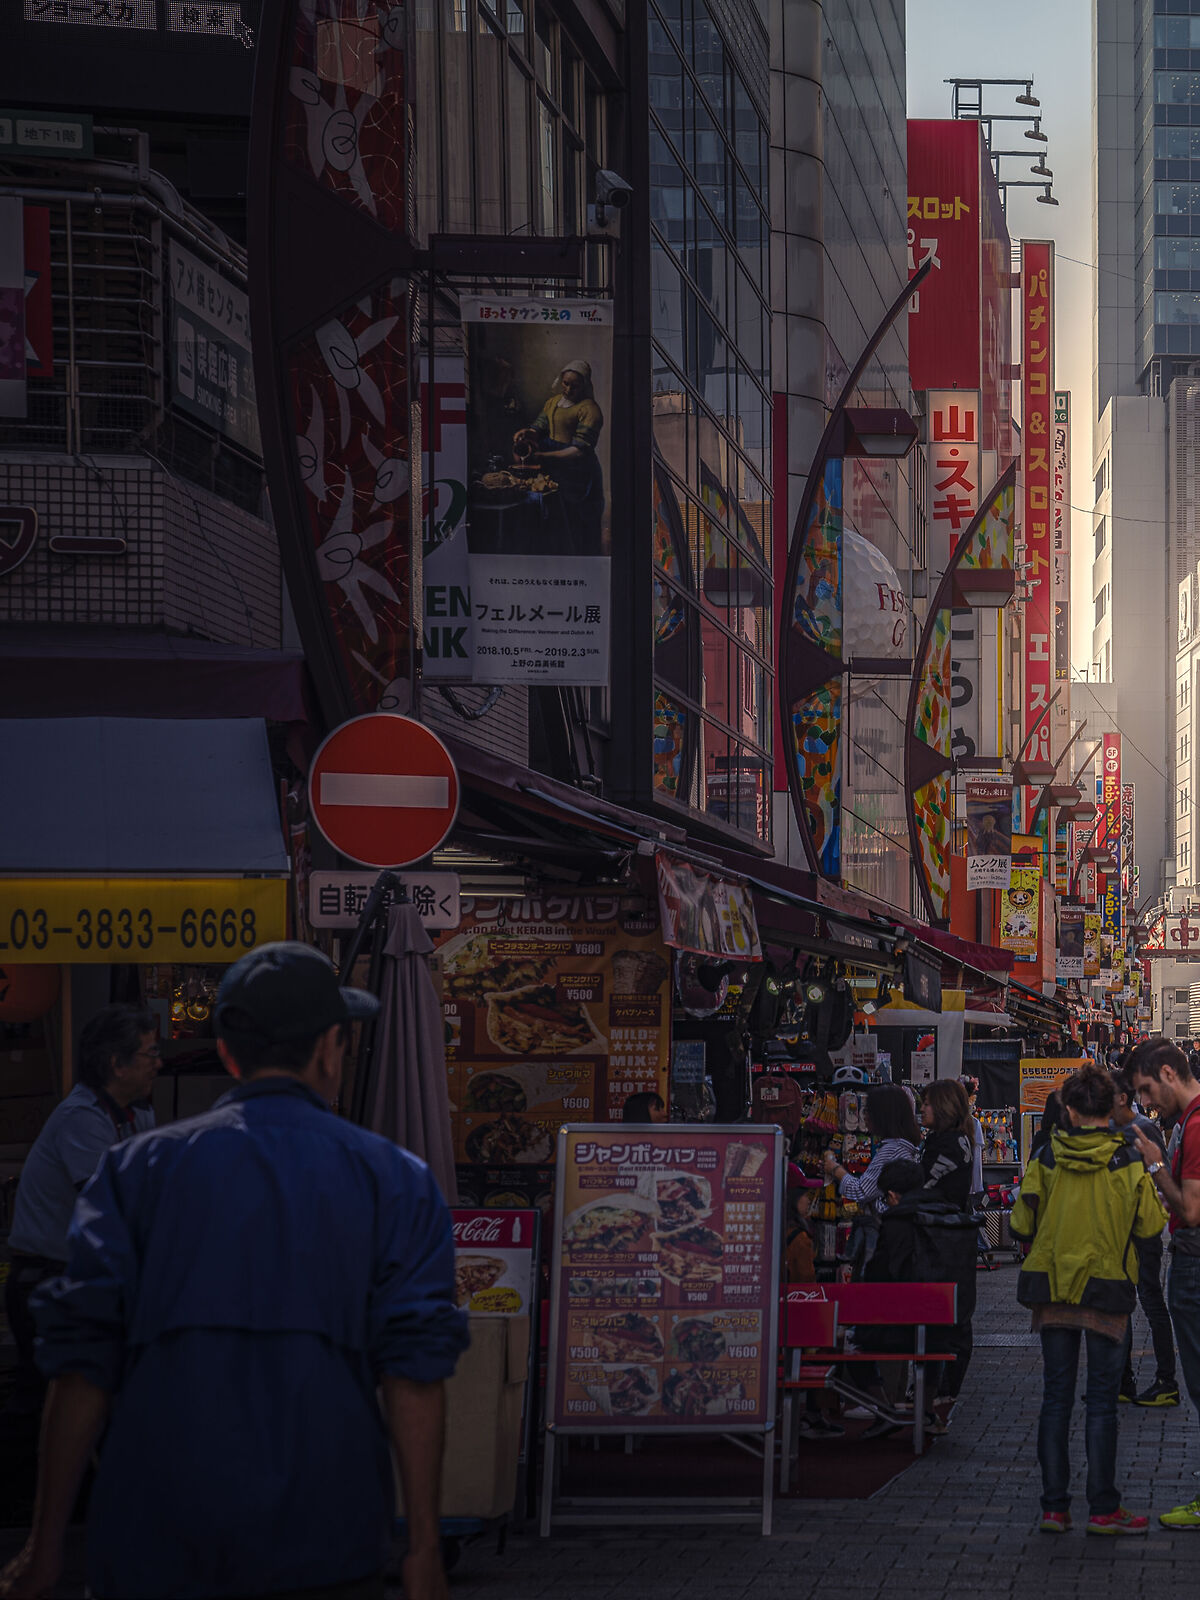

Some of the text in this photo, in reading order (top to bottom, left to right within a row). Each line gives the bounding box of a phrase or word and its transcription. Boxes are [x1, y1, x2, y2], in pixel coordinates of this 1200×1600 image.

[23, 127, 77, 143] 地下1階
[908, 197, 970, 220] スロット
[480, 307, 571, 320] ほっとタウンうえの
[475, 604, 601, 623] フェルメール展
[477, 646, 519, 656] 2018.10.5
[545, 647, 586, 657] 2019.2.3
[970, 857, 1007, 869] ムンク展
[320, 884, 451, 916] 自転除く
[517, 926, 553, 936] KEBAB
[575, 943, 601, 955] ¥600
[567, 988, 594, 1001] ¥500
[610, 1029, 647, 1040] MILD
[609, 1056, 648, 1067] MIX
[609, 1082, 646, 1093] HOT
[563, 1098, 590, 1109] ¥600
[576, 1143, 696, 1164] ジャンボケバブ
[615, 1178, 636, 1187] ¥600
[725, 1203, 756, 1213] MILD
[725, 1224, 754, 1233] MIX
[724, 1244, 753, 1253] HOT
[637, 1253, 659, 1263] ¥600
[687, 1292, 708, 1302] ¥500
[569, 1347, 599, 1359] ¥500
[729, 1345, 758, 1358] ¥600
[567, 1399, 597, 1412] ¥600
[726, 1399, 756, 1412] ¥600
